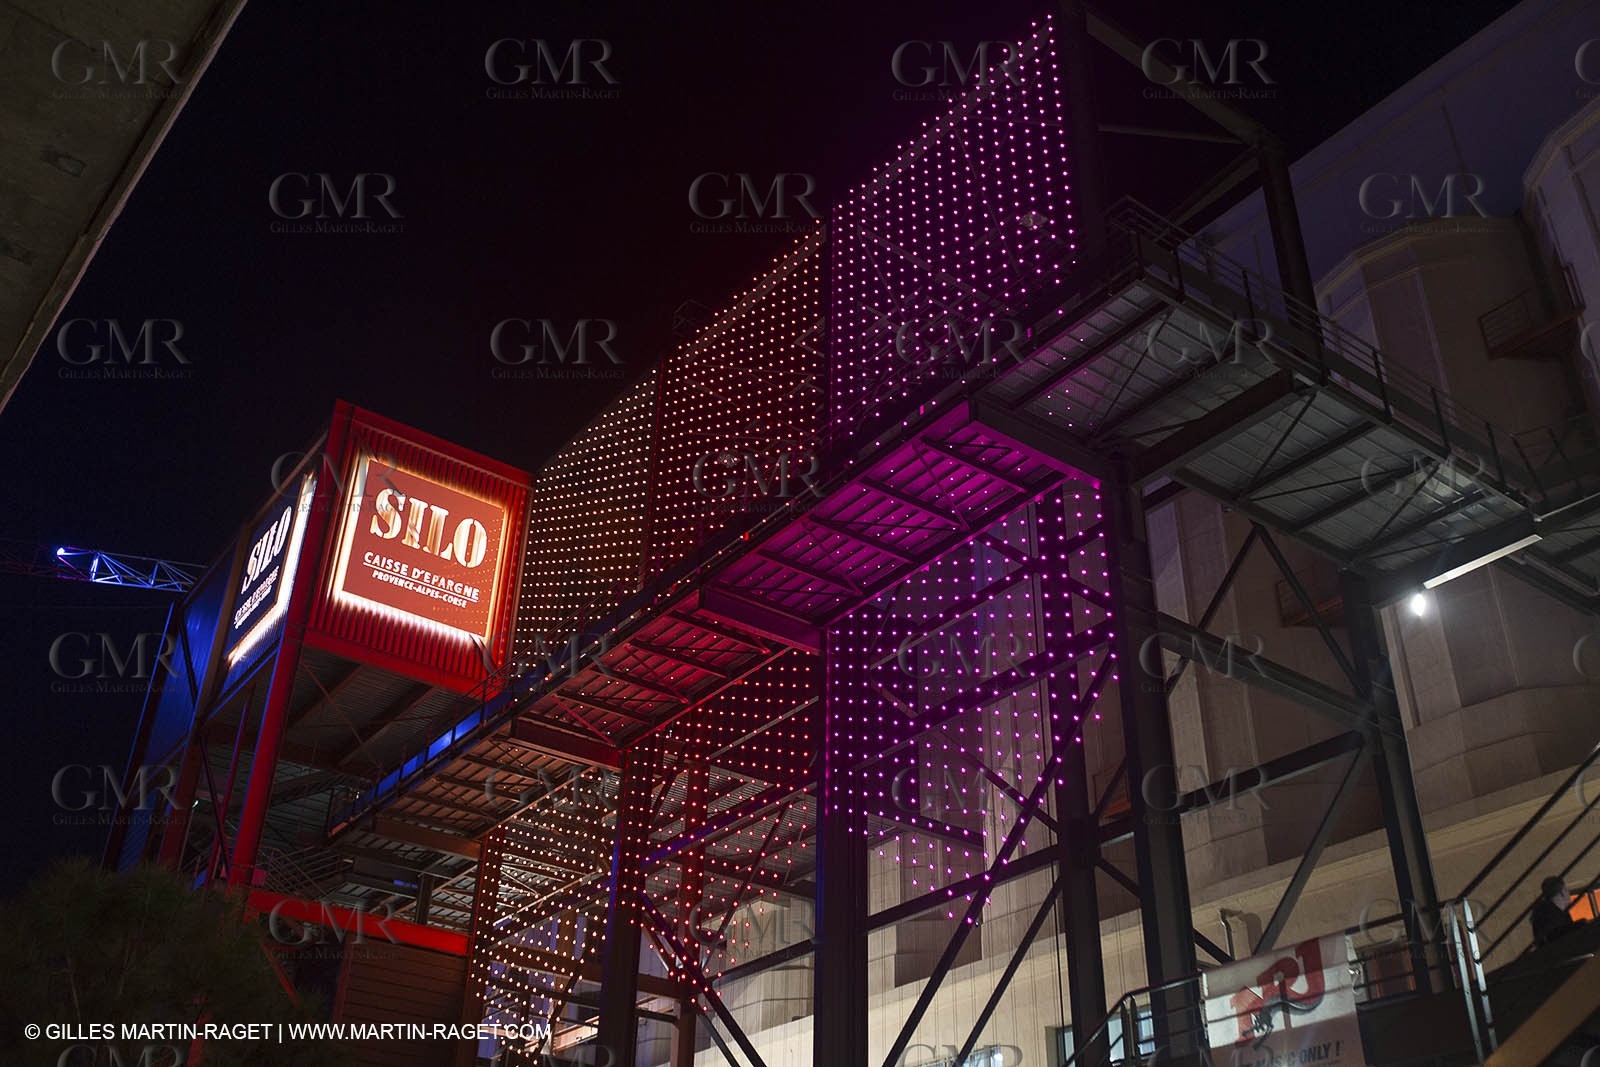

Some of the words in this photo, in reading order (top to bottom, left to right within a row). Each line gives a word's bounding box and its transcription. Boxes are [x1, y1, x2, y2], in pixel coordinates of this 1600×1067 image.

[241, 506, 292, 594] SILO
[370, 488, 488, 568] SILO
[363, 552, 409, 576] CAISSE
[411, 567, 480, 600] D'EPARGNE
[372, 570, 467, 609] PROVENCE-ALPES-CORSE
[1230, 937, 1326, 1045] NRJ
[1299, 1041, 1332, 1064] ONLY
